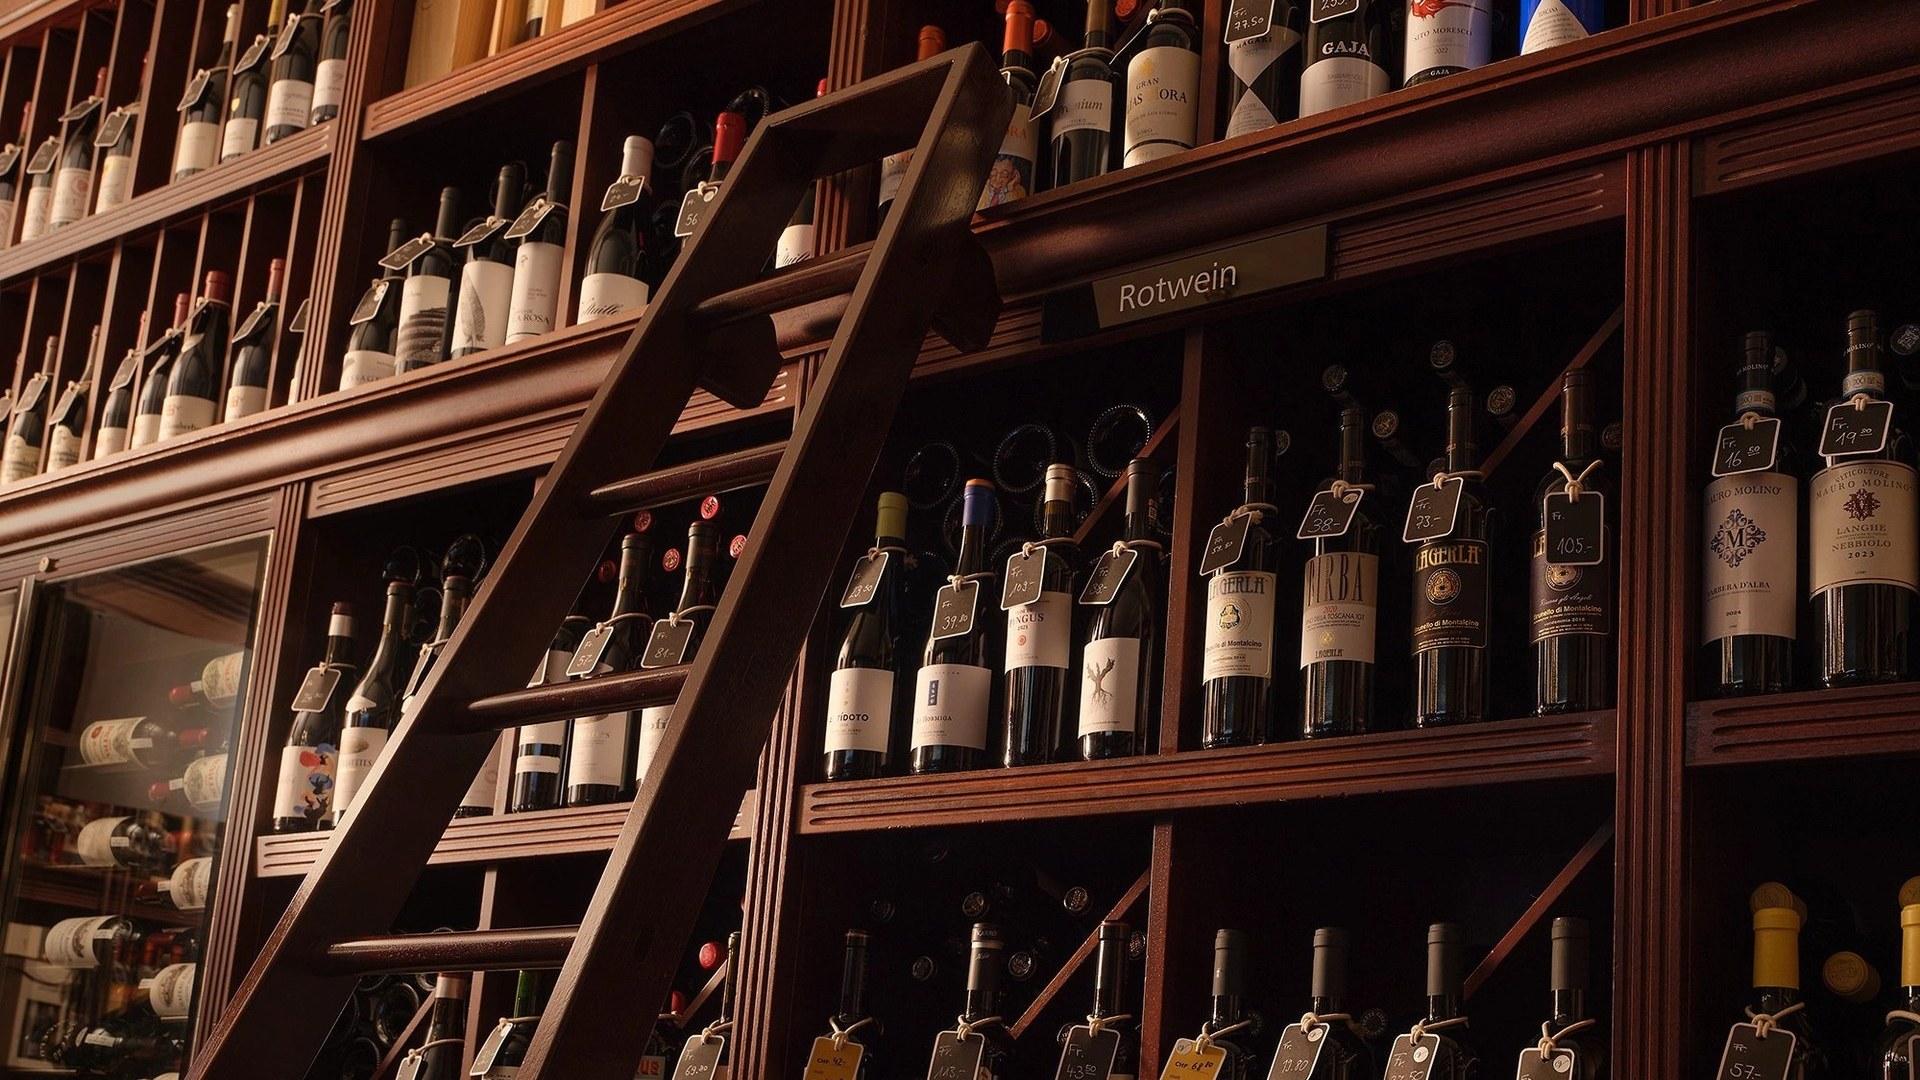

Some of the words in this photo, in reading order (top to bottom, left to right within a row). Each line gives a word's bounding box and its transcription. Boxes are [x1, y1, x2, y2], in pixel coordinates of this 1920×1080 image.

[1432, 27, 1472, 36] MORESCO
[1321, 40, 1371, 57] GAJA
[1136, 78, 1160, 90] GRAN
[1119, 261, 1237, 312] Rotwein
[1831, 417, 1849, 431] Fr.
[1722, 437, 1737, 449] Fr.
[1834, 431, 1857, 446] 19
[1725, 450, 1742, 468] 16
[1835, 468, 1889, 483] VITICOLTORE
[1708, 489, 1732, 505] AURO
[1734, 485, 1780, 497] MOLINO
[1816, 480, 1856, 500] MAURO
[1862, 479, 1910, 492] MOLINO
[1311, 503, 1327, 517] Fr.
[1551, 511, 1565, 520] Fr.
[1307, 517, 1341, 533] 38.-
[1836, 524, 1887, 536] LANGHE
[1556, 536, 1592, 554] 105.-
[1831, 540, 1892, 552] NEBBIOLO
[1847, 551, 1876, 559] 2023
[1306, 552, 1364, 607] BIRBA
[1740, 581, 1771, 589] D'ALBA
[1555, 605, 1563, 613] di
[1563, 604, 1602, 612] Montalcino
[1327, 612, 1355, 621] TOSCANA
[1434, 619, 1441, 627] di
[1442, 618, 1479, 627] Montalcino
[1228, 639, 1263, 649] Montalcino
[1068, 1043, 1085, 1059] Fr.
[1174, 1061, 1188, 1069] CHF
